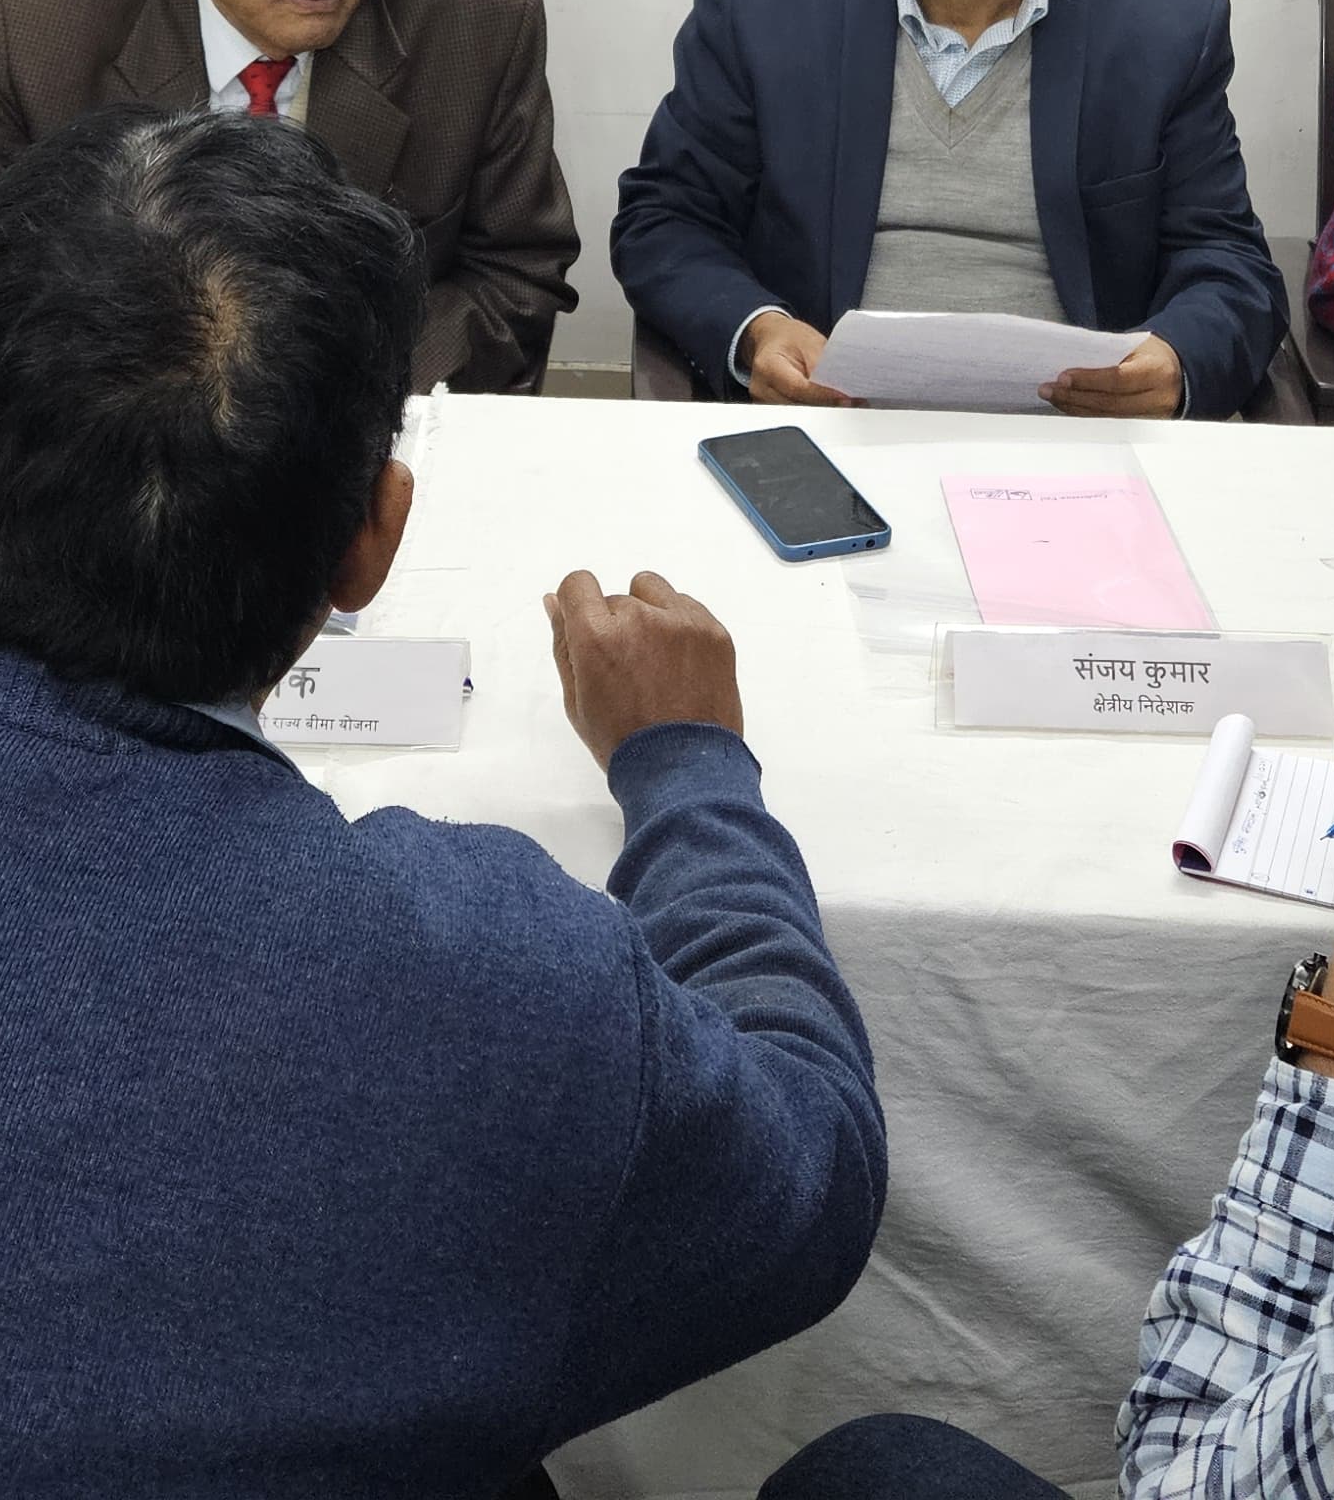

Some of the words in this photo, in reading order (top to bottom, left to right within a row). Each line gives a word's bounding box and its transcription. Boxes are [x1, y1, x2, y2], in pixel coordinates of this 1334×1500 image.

[1072, 652, 1136, 682] संजय
[1142, 660, 1212, 689] कुमार
[1093, 692, 1133, 714] क्षेत्रीय
[1138, 693, 1195, 716] निदेशक
[272, 716, 302, 730] राज्य
[305, 713, 335, 730] बीमा
[338, 714, 380, 732] योजना
